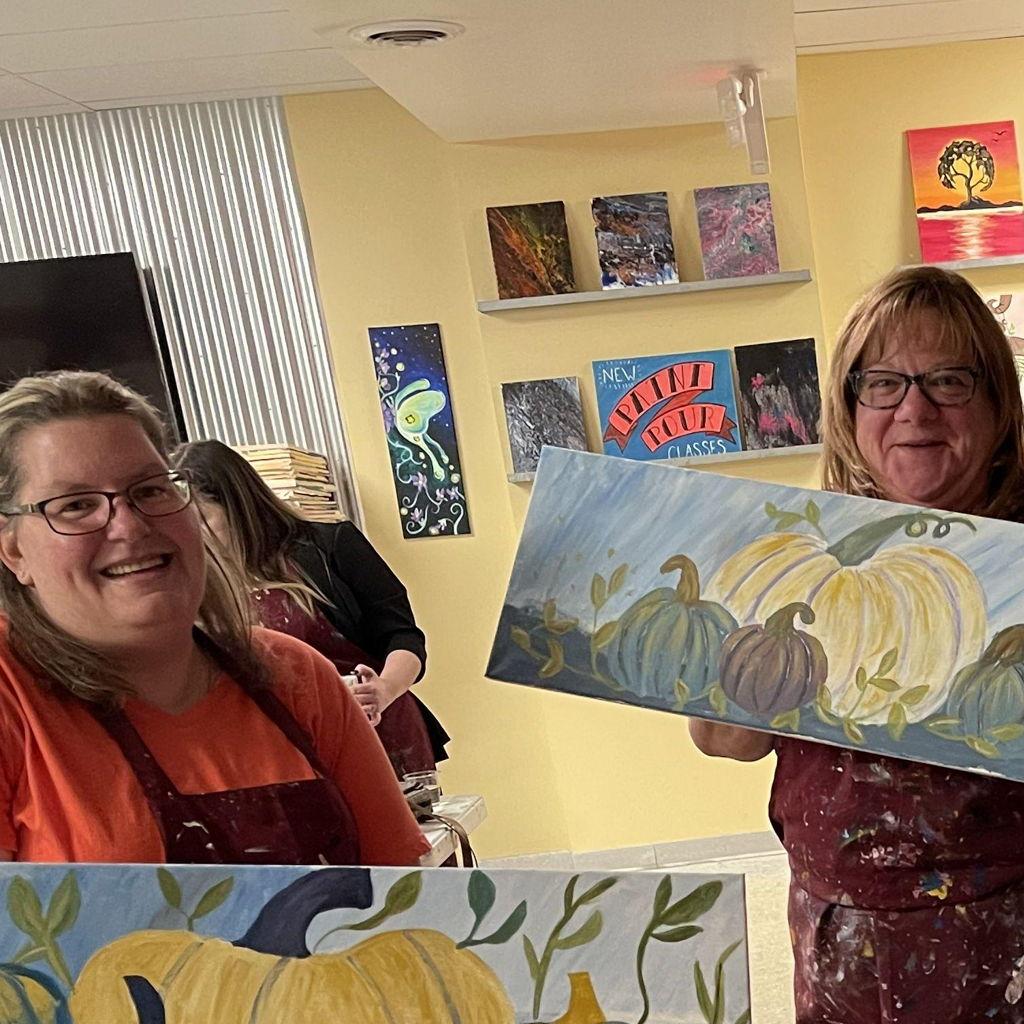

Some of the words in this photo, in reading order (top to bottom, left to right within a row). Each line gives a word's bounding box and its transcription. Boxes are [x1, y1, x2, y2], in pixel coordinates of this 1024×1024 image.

[602, 365, 636, 383] NEW
[615, 363, 706, 425] PAINT
[646, 405, 714, 446] POUR
[667, 440, 727, 460] CLASSES
